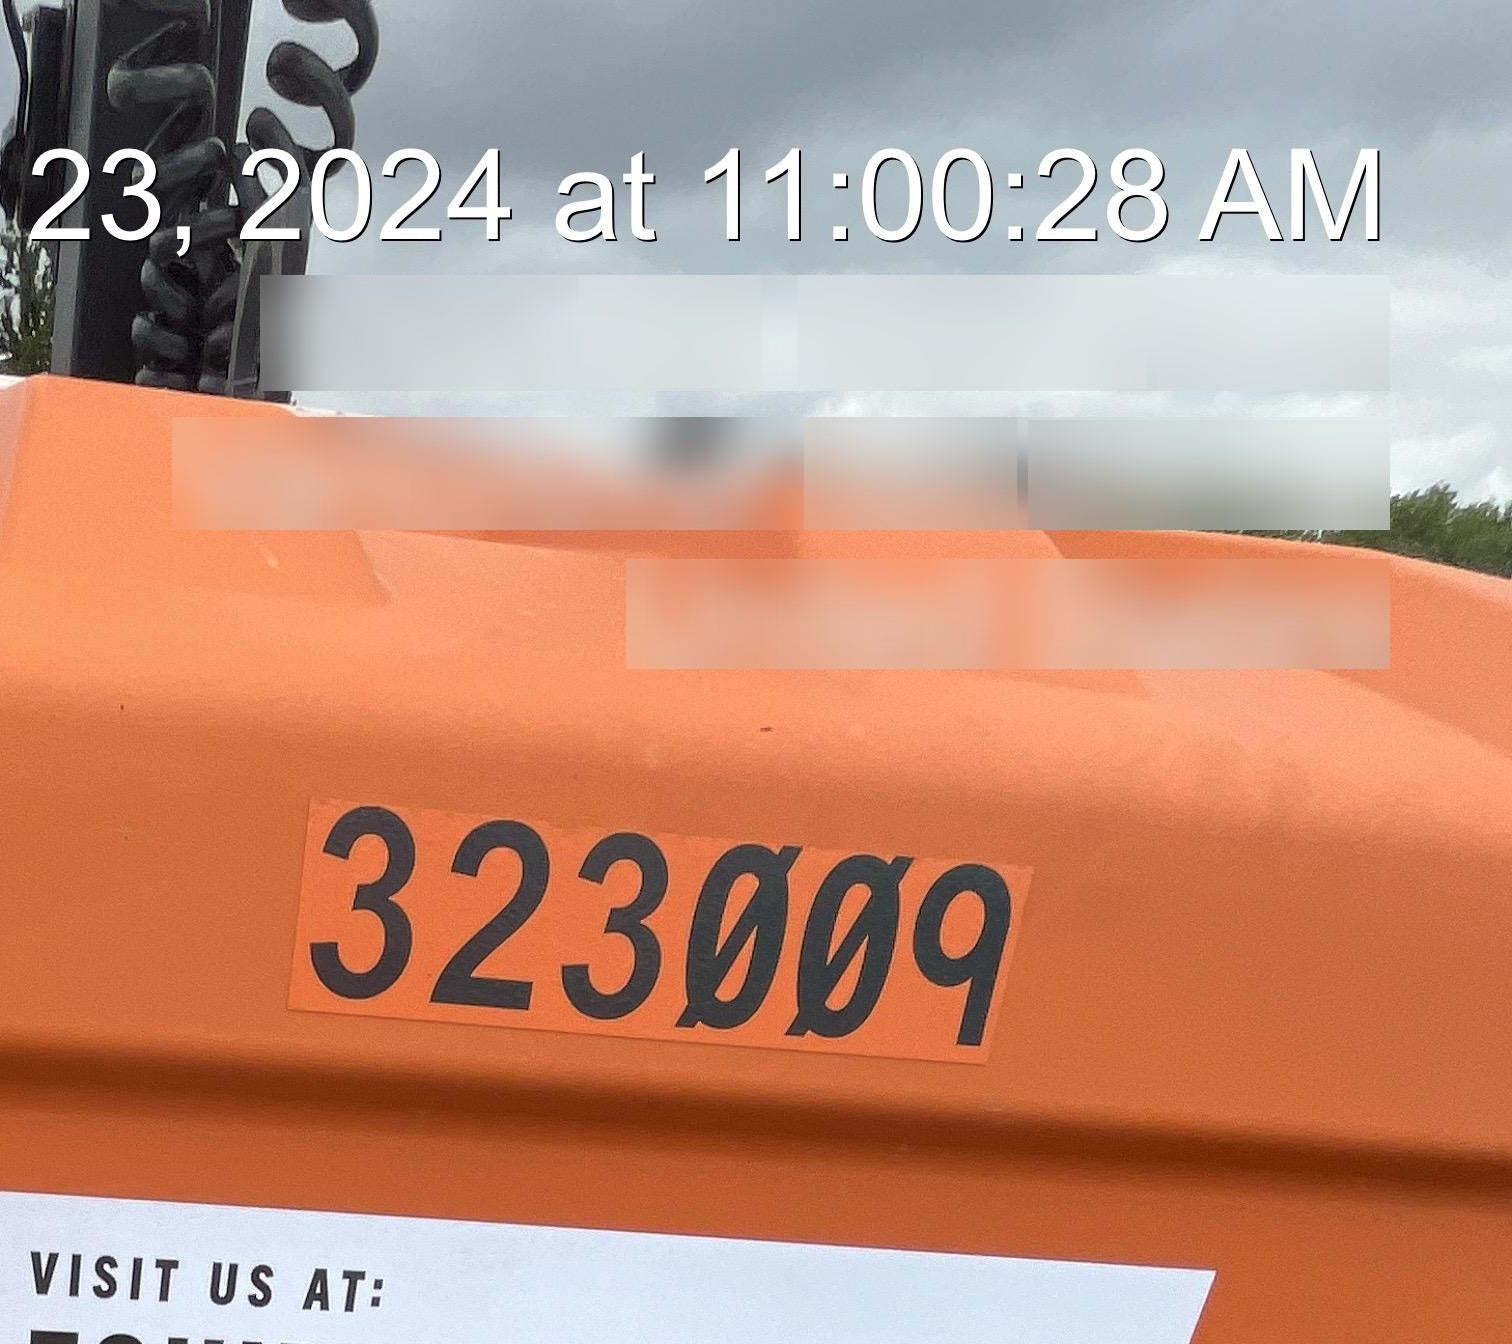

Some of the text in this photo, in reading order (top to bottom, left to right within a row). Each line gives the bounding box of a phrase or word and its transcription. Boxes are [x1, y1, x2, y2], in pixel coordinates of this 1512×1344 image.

[30, 1250, 384, 1313] VISIT US AT:
